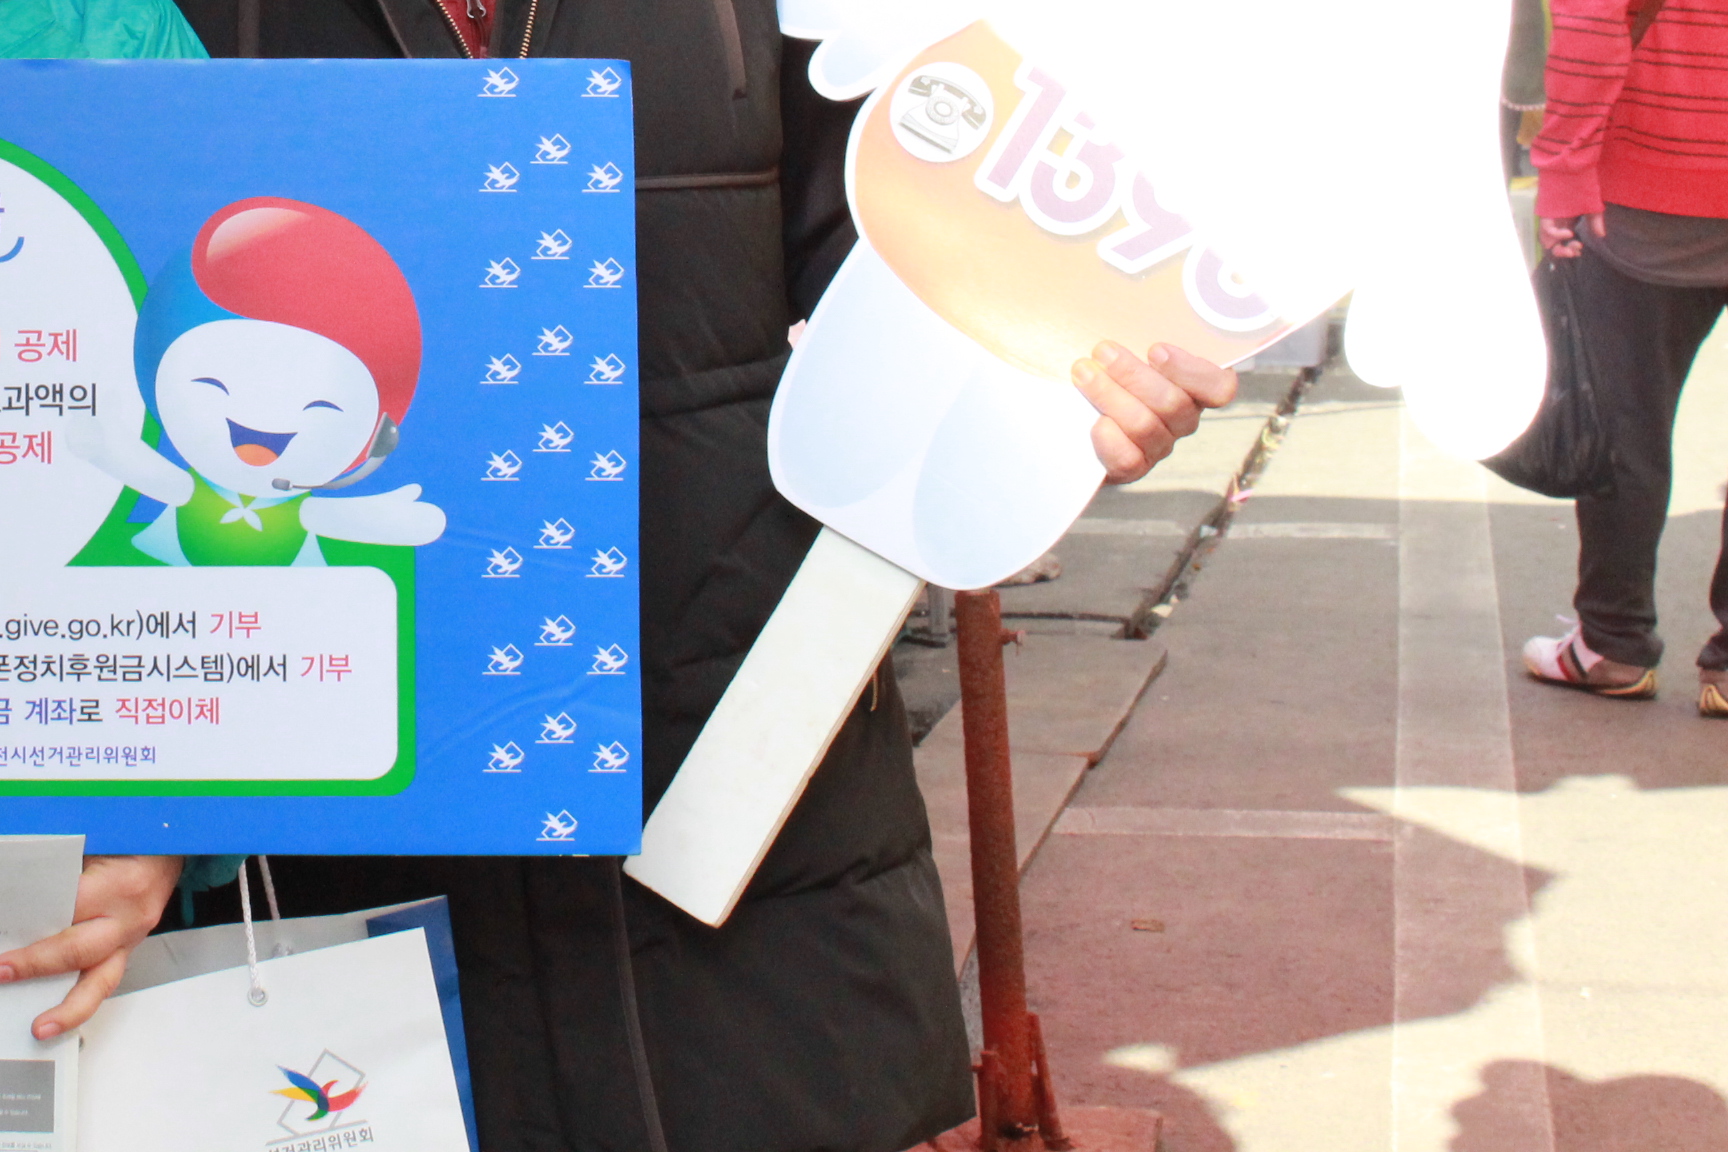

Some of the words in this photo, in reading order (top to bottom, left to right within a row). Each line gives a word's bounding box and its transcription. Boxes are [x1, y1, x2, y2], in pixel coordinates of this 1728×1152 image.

[13, 328, 79, 363] 공제
[209, 610, 262, 639] 기부
[300, 653, 353, 682] 기부
[24, 697, 104, 725] 계좌로
[114, 696, 221, 725] 직접이체
